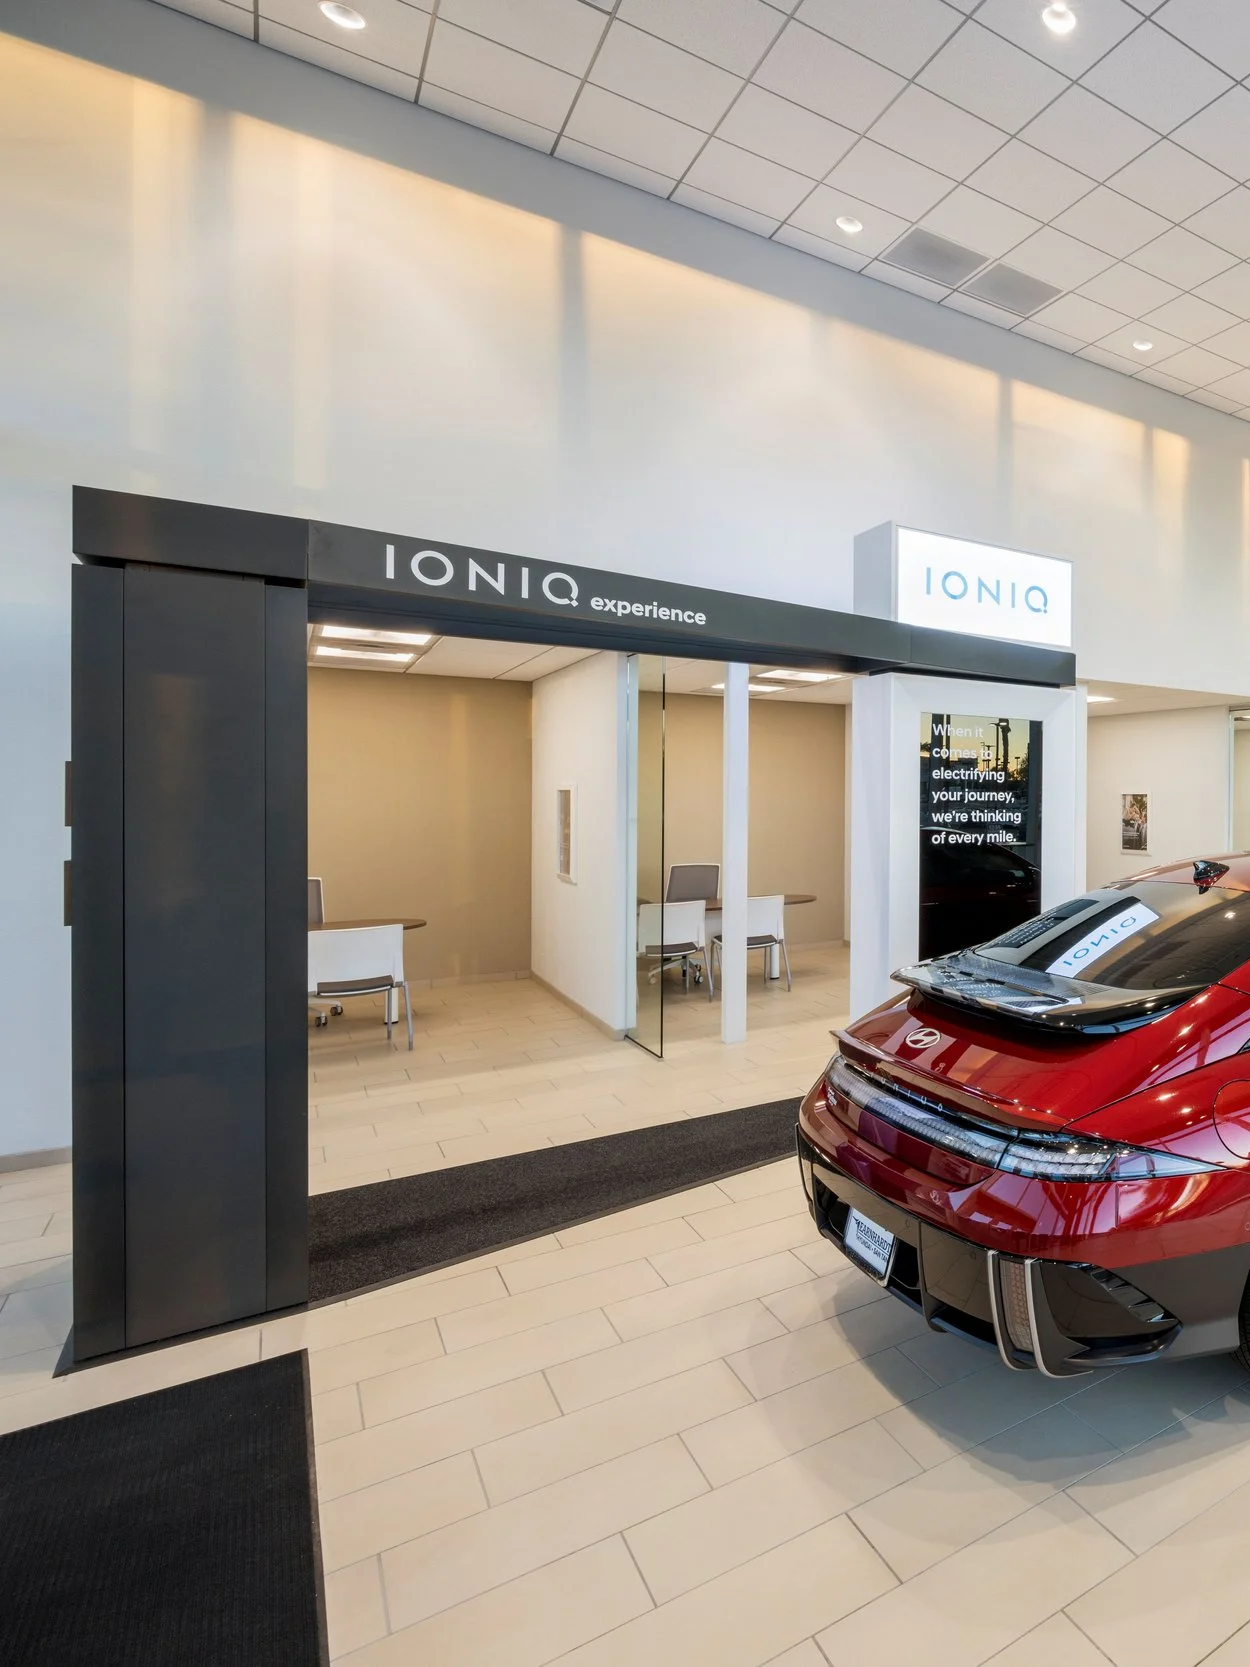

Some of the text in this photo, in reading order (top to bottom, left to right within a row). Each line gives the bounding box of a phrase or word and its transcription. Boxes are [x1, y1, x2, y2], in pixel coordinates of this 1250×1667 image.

[386, 544, 707, 625] IONIQ experience
[925, 567, 1048, 614] IONIQ
[932, 723, 984, 738] When it
[932, 748, 993, 759] comes to
[932, 767, 1005, 783] electrifying
[932, 789, 1015, 803] your journey,
[932, 810, 1022, 824] we're thinking
[931, 830, 1016, 845] of every mile.
